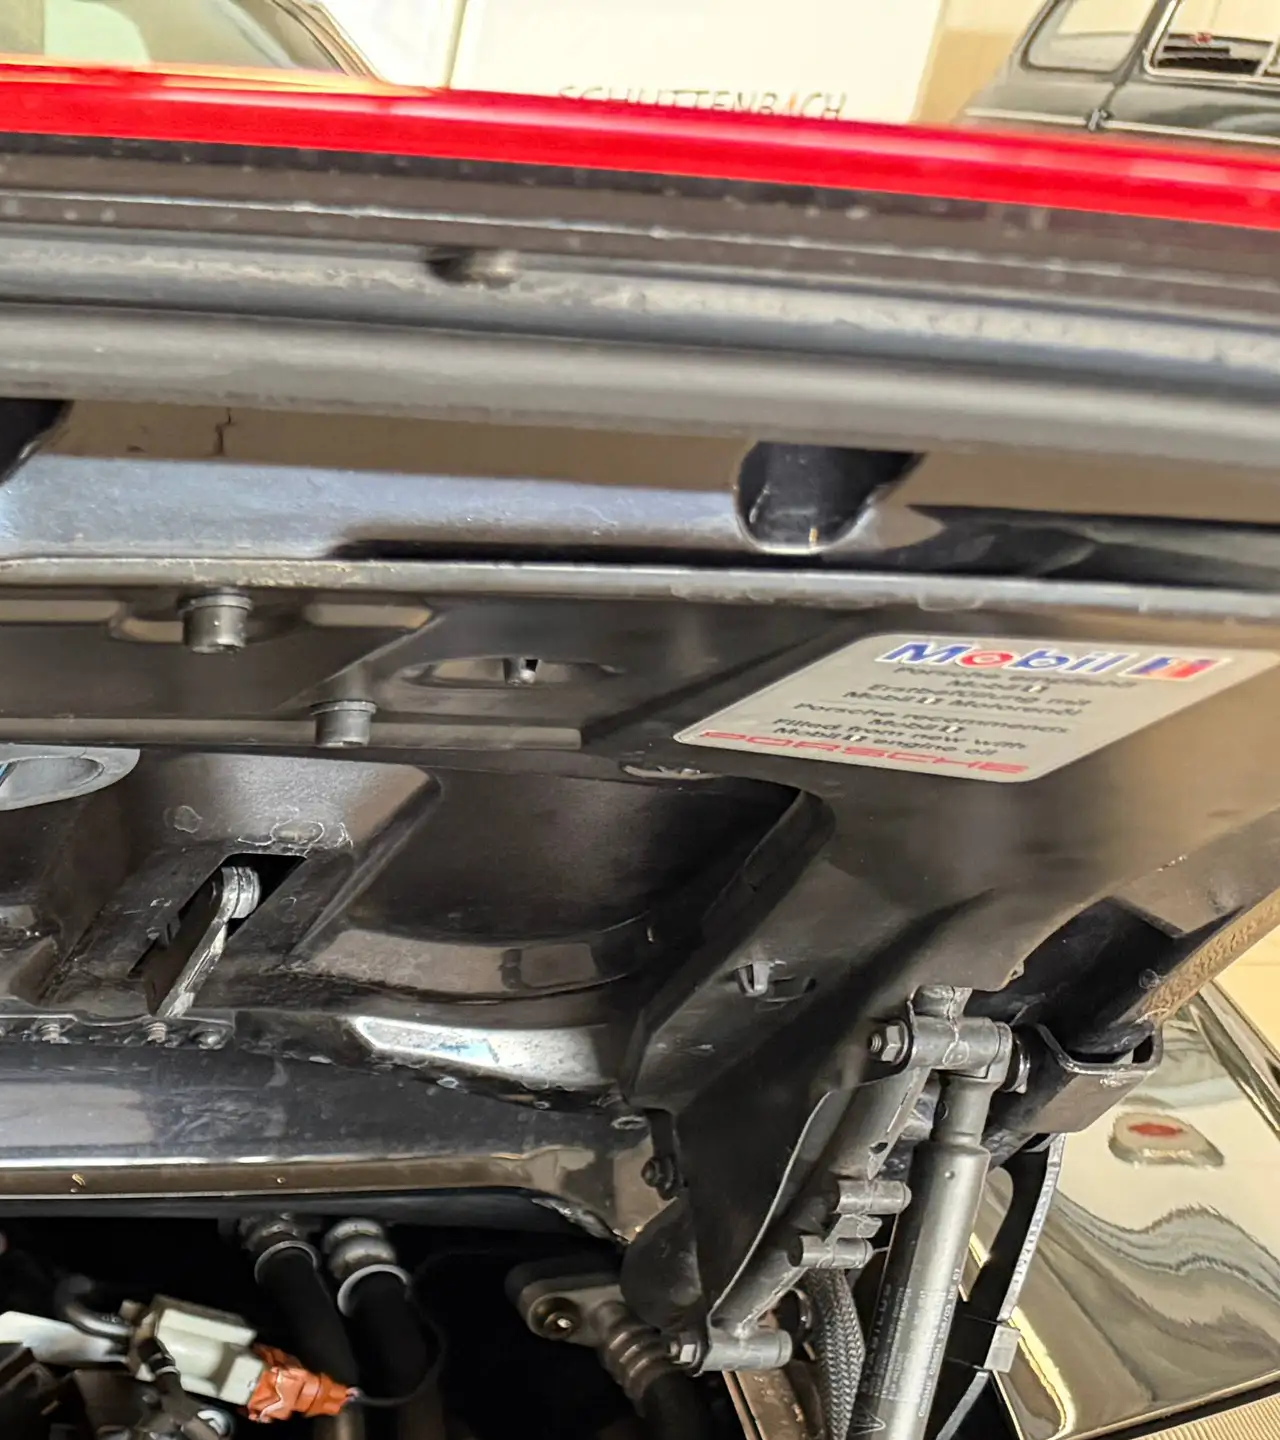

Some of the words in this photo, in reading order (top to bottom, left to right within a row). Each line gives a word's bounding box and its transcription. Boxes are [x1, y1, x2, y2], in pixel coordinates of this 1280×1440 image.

[878, 641, 1131, 675] Mobil
[893, 667, 1001, 679] Porsche
[945, 679, 1021, 691] Mobil
[842, 691, 917, 702] Mobil
[793, 702, 896, 718] Porsche
[902, 712, 1071, 734] recommends
[867, 718, 939, 731] Mobil
[772, 727, 842, 741] Mobil
[873, 737, 958, 752] engine
[846, 725, 905, 737] from
[911, 733, 966, 743] new
[974, 738, 1027, 750] with
[699, 729, 1030, 775] PORSCHE
